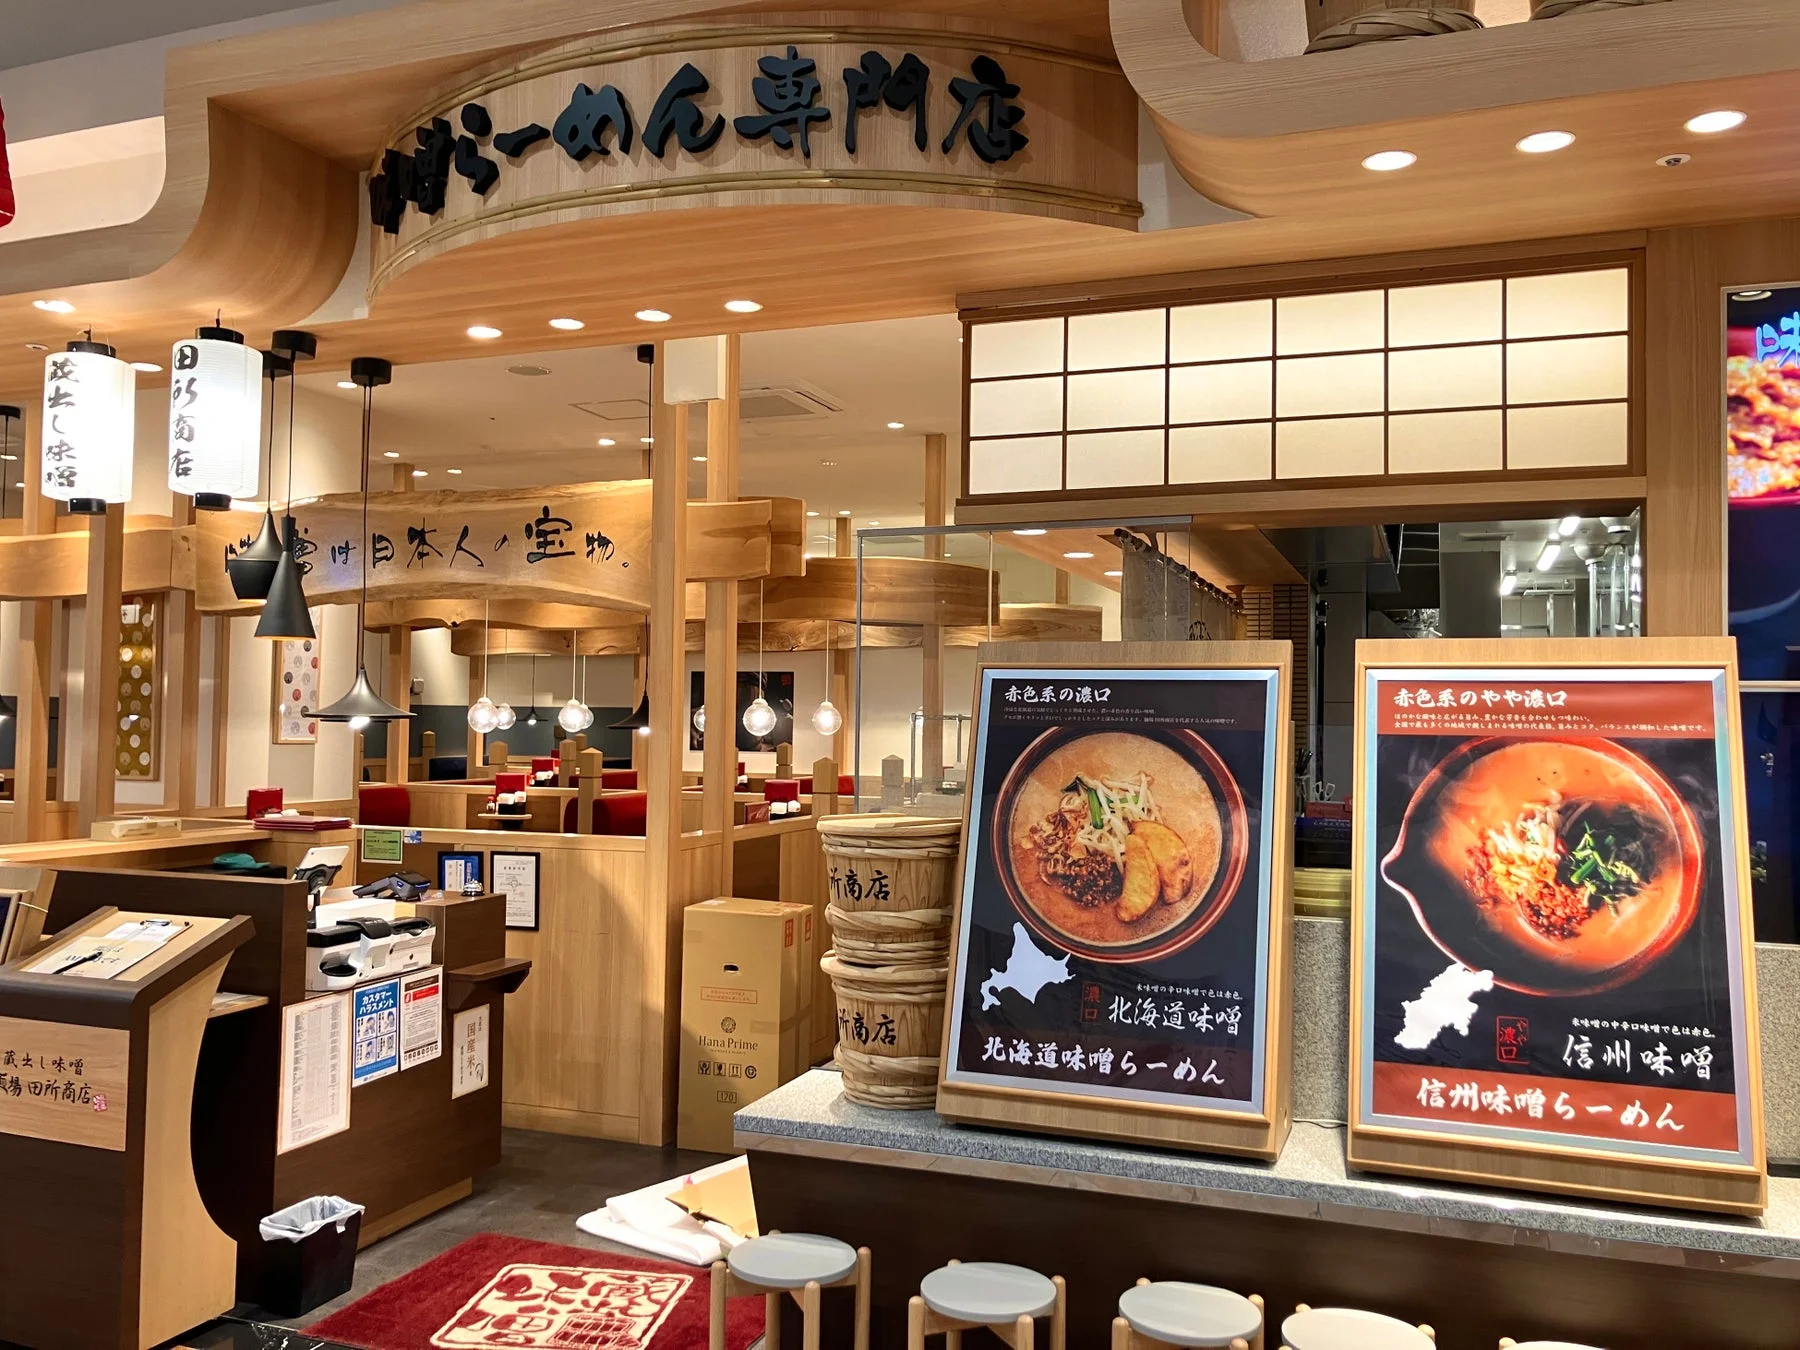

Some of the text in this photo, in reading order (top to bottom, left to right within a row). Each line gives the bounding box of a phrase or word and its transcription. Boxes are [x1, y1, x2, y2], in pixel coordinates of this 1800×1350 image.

[45, 357, 80, 488] 蔵出し味噌
[169, 344, 200, 478] 田所商店
[225, 505, 630, 576] は日本人の宝物。
[1004, 685, 1112, 703] 赤色系の濃口
[1393, 688, 1568, 708] 赤色系のやや濃口
[360, 998, 394, 1014] ハラスメント
[362, 991, 392, 1006] カスタマー
[1108, 995, 1242, 1036] 北海道味噌
[698, 1035, 758, 1051] Hana Prime
[1562, 1034, 1714, 1080] 信州味噌
[4, 1049, 84, 1076] 蔵出し味噌
[982, 1036, 1225, 1085] 北海道味噌らーめん
[28, 1079, 92, 1104] 田所商店
[1417, 1077, 1685, 1132] 信州味噌らーめん
